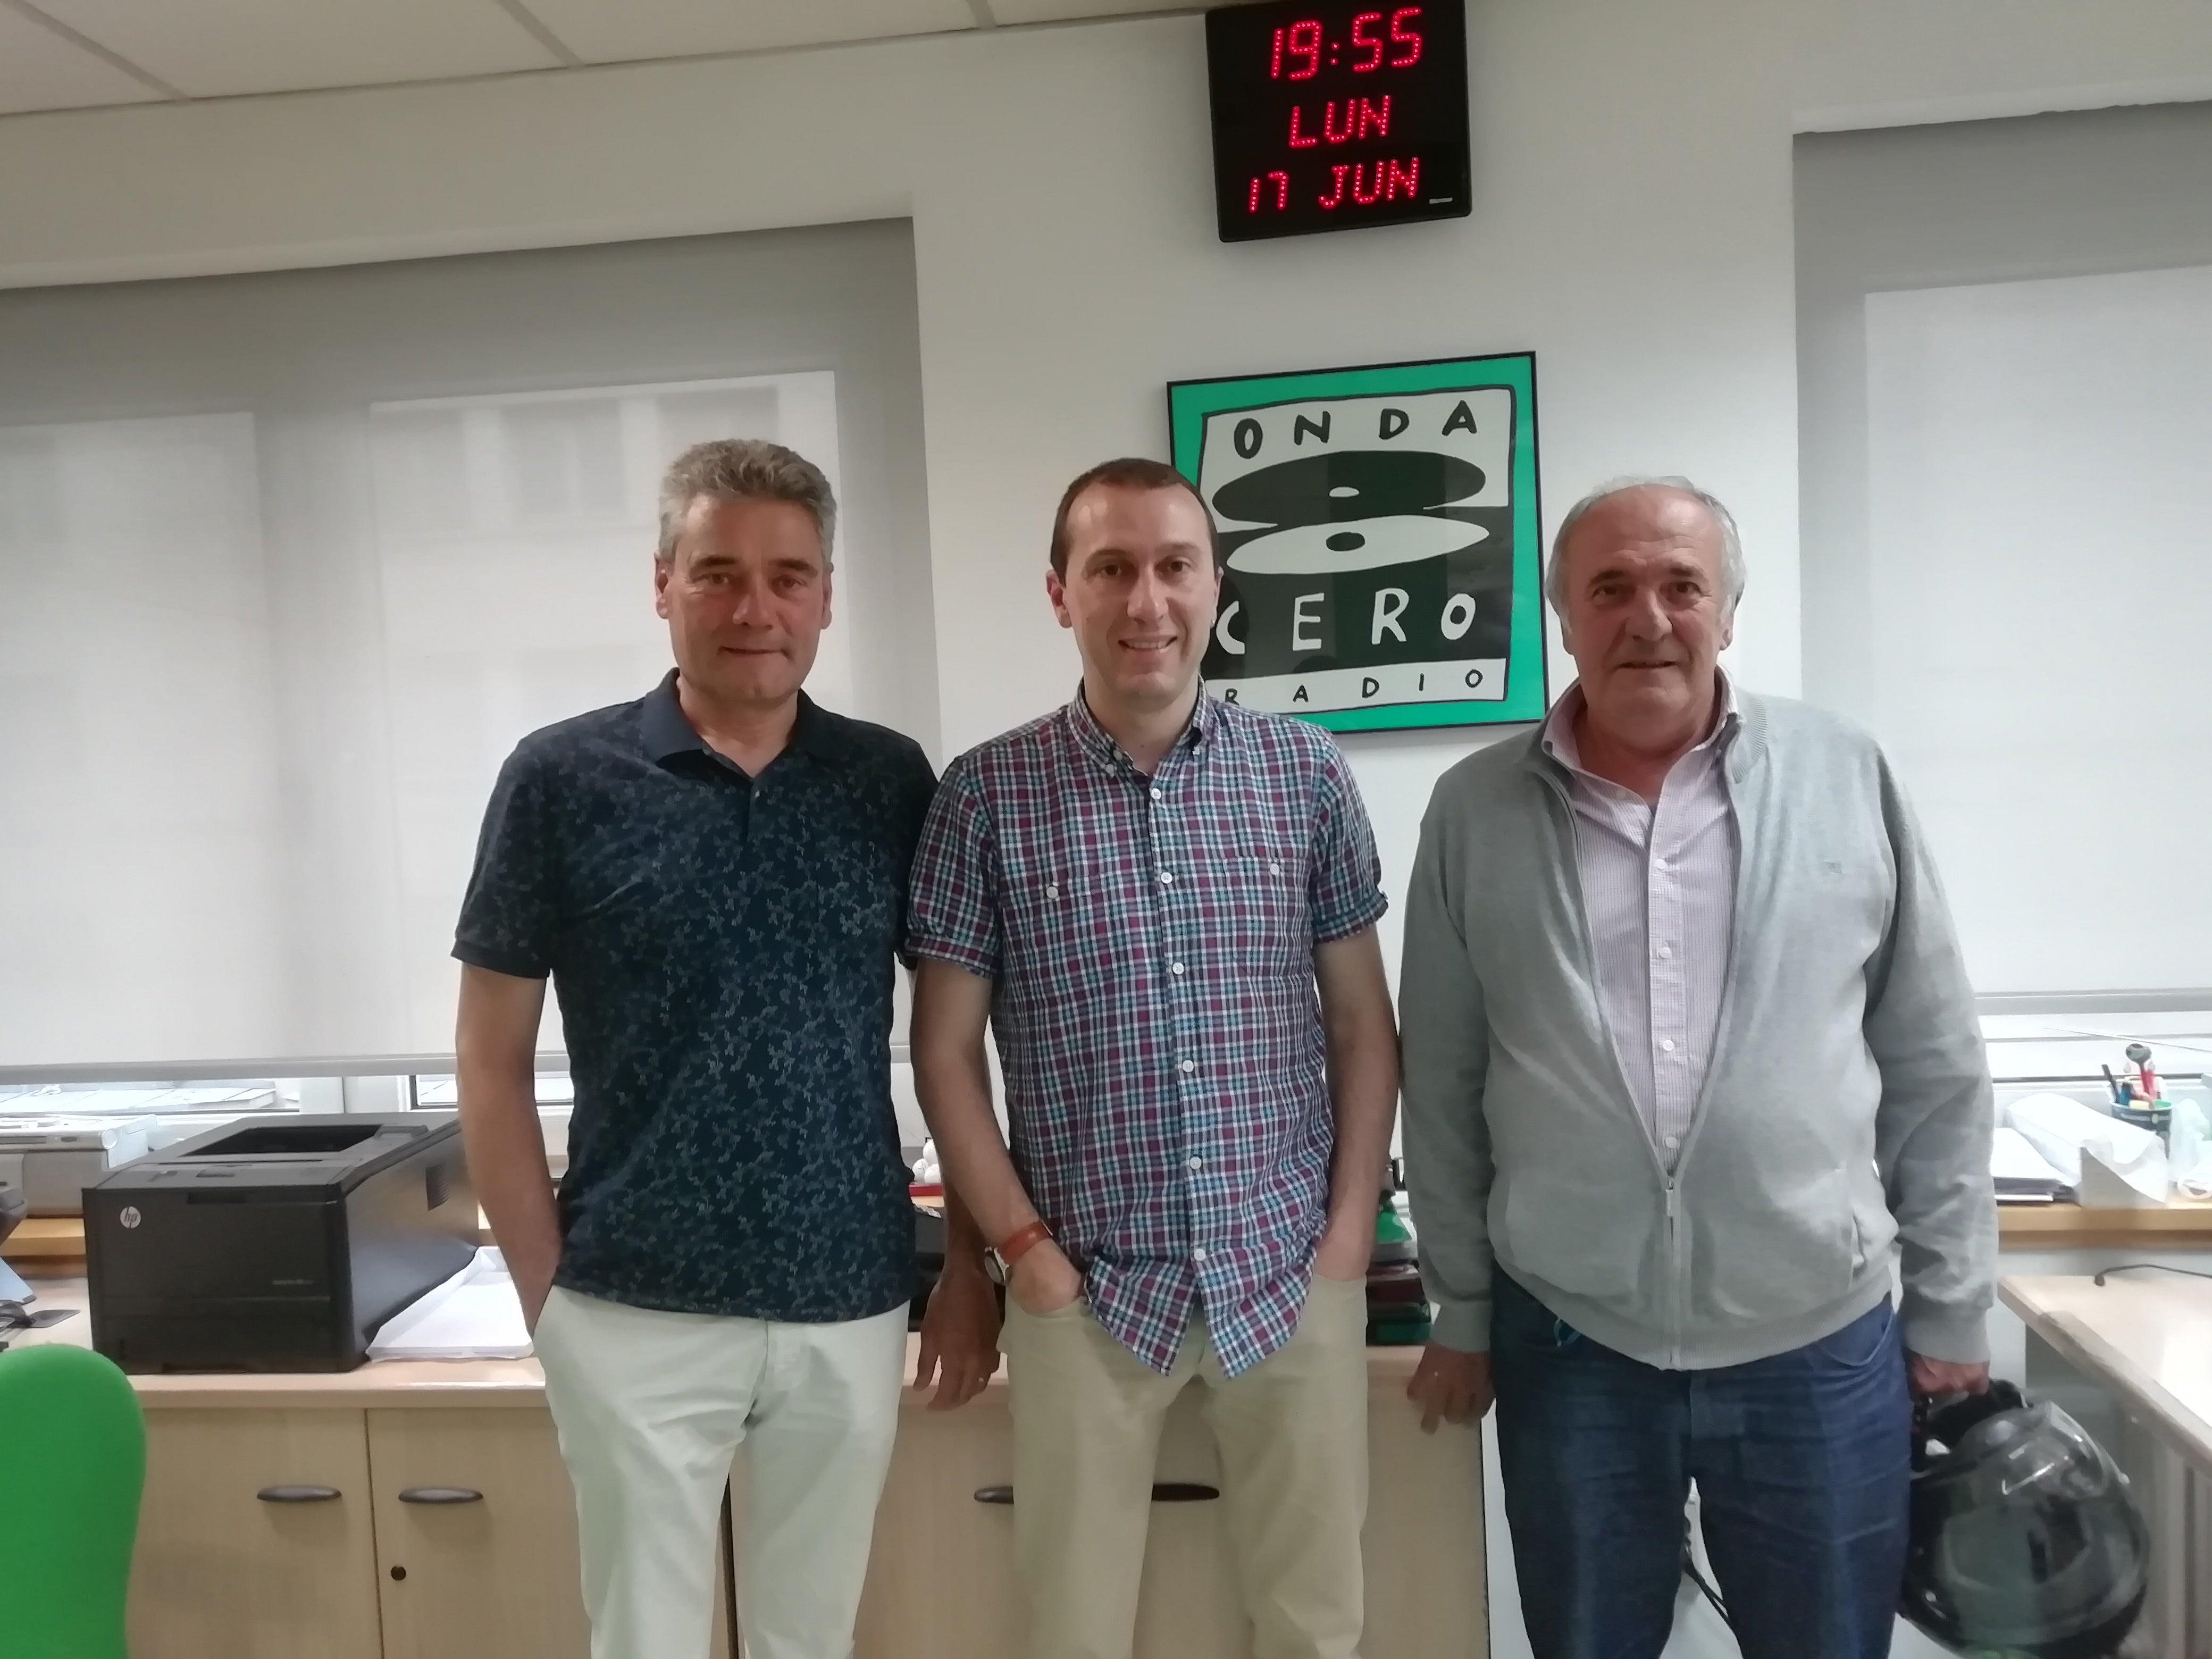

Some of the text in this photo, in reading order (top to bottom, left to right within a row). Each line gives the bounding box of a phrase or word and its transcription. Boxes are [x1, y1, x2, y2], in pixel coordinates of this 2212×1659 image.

[1271, 7, 1422, 80] 19:55
[1289, 94, 1391, 148] LUN
[1249, 157, 1419, 212] 17 JUN
[1234, 400, 1477, 459] ONDA
[1216, 588, 1477, 655] CERO
[1225, 668, 1483, 706] RADIO
[122, 1206, 139, 1228] hp
